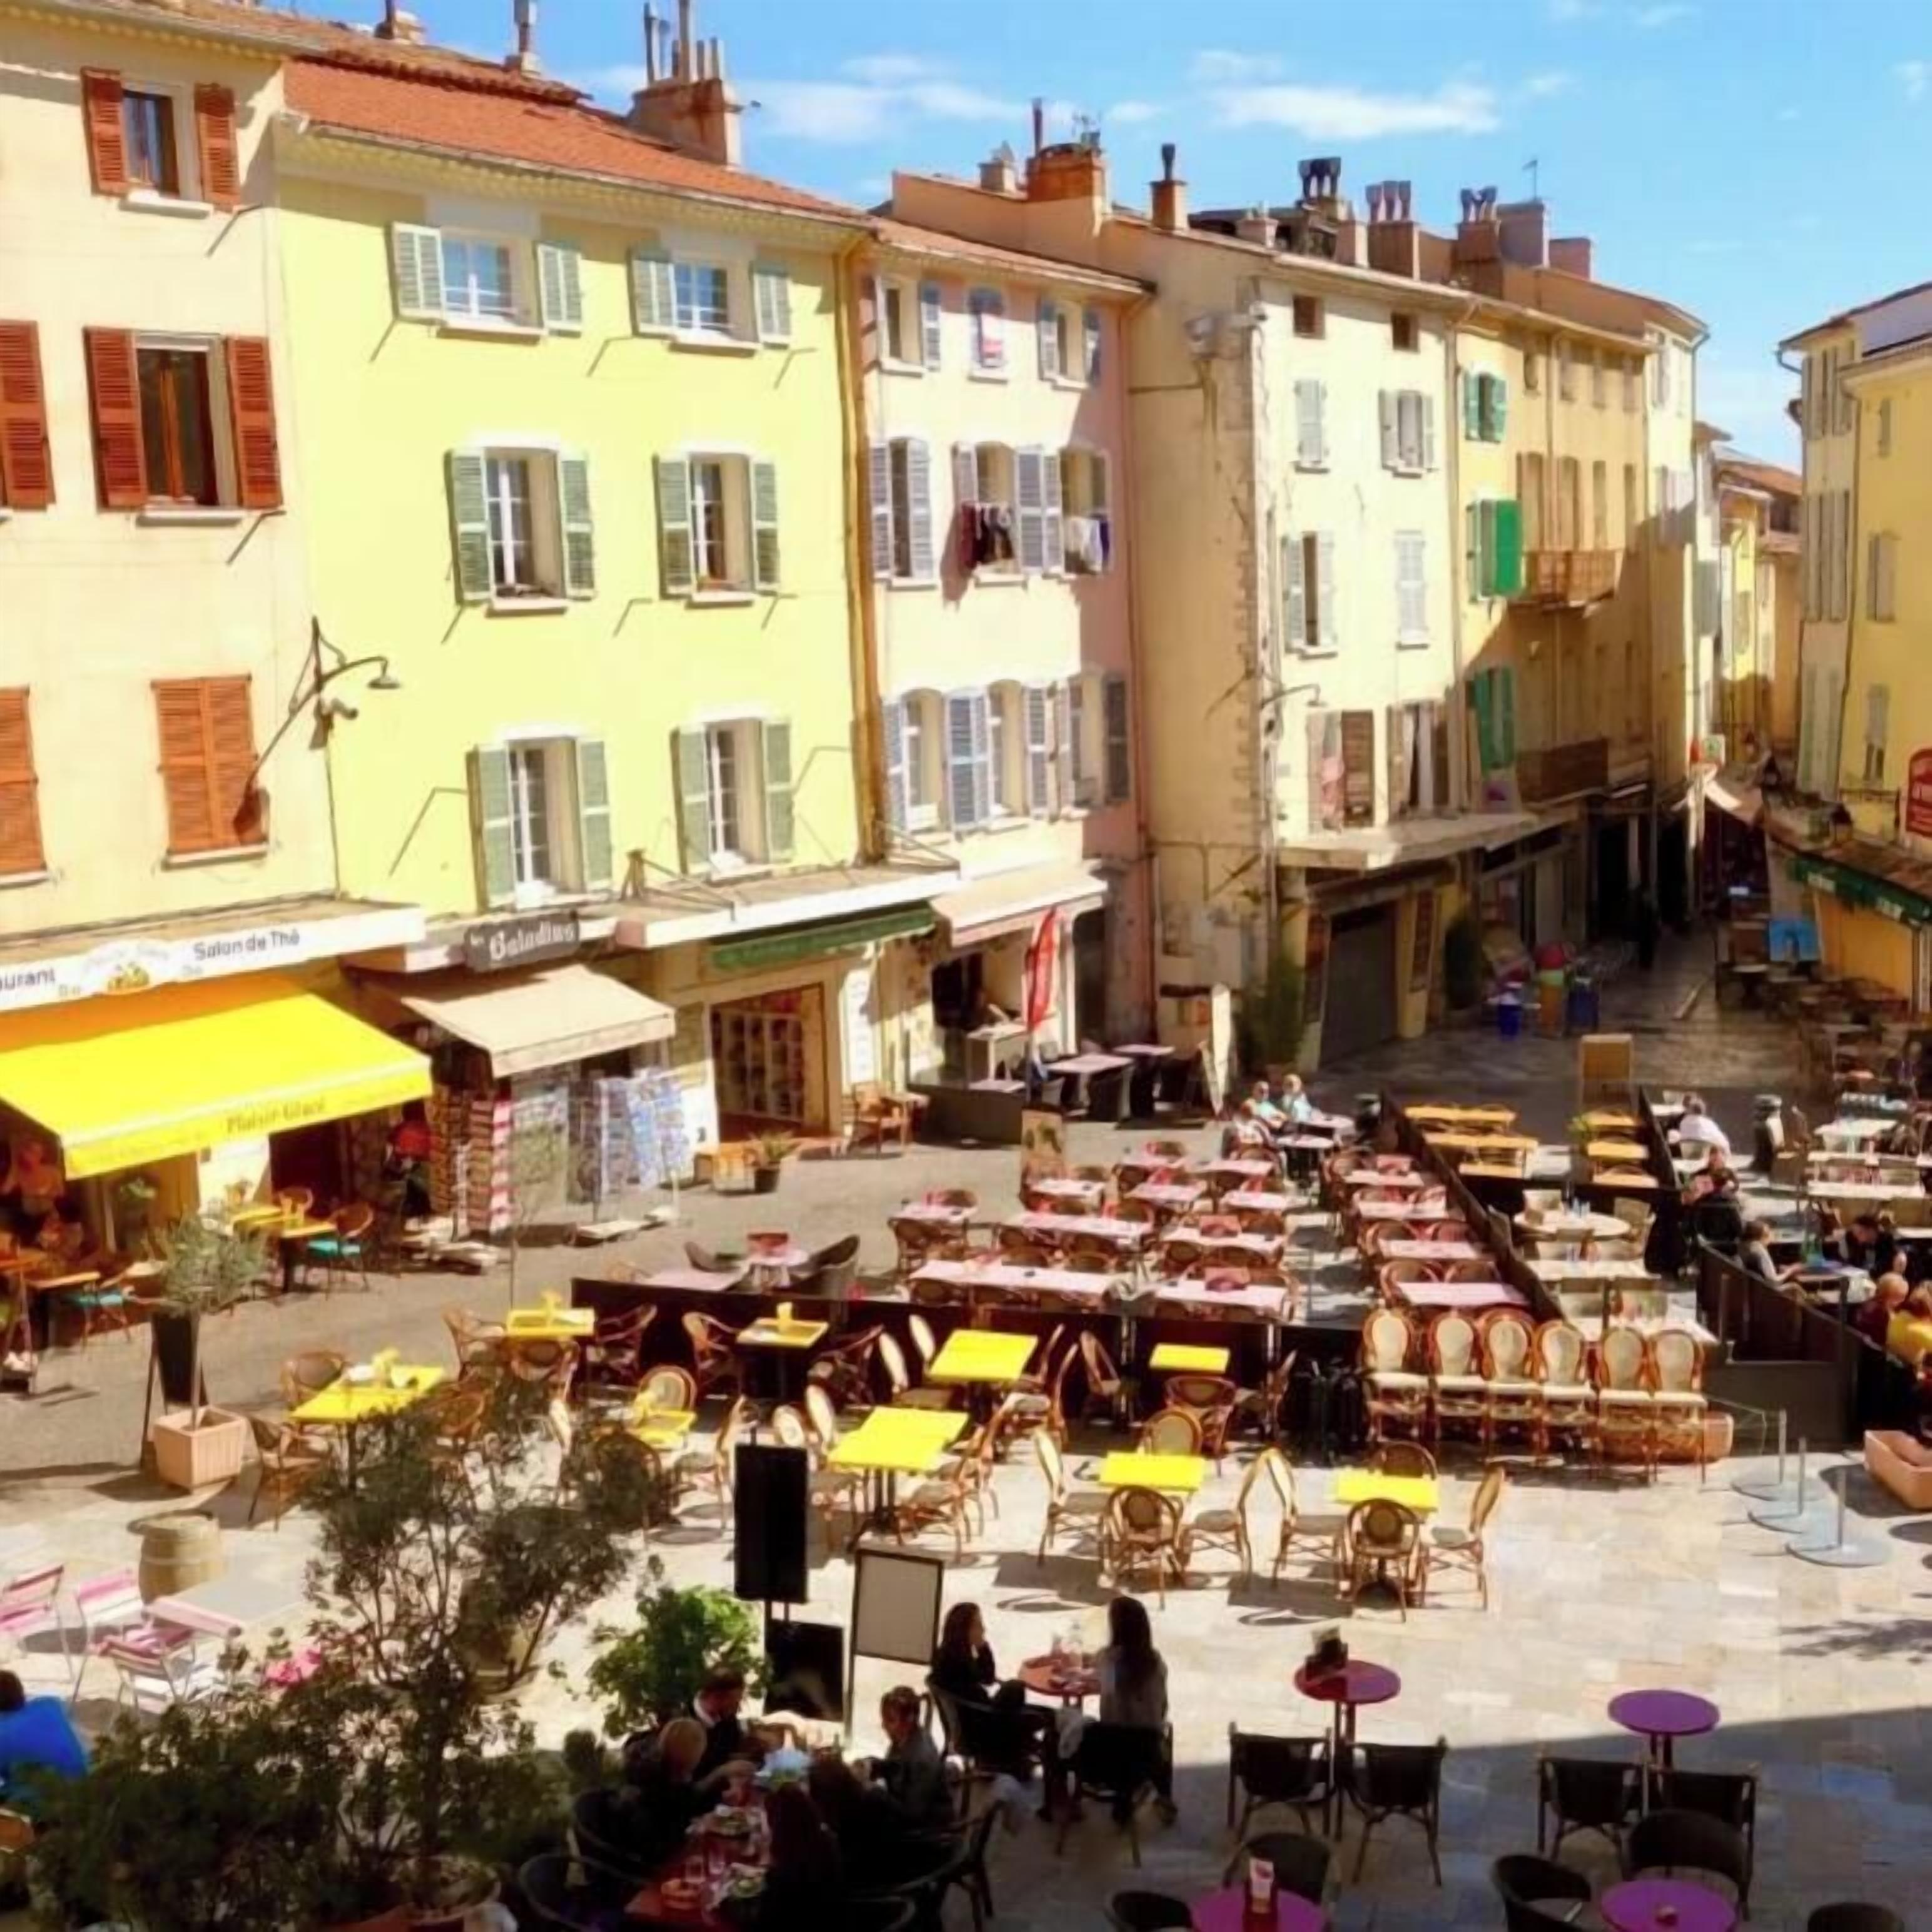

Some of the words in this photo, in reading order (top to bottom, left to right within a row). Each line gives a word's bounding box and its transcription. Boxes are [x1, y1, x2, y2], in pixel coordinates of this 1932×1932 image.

[193, 941, 243, 961] Salon
[245, 933, 266, 952] de
[0, 967, 55, 990] urant
